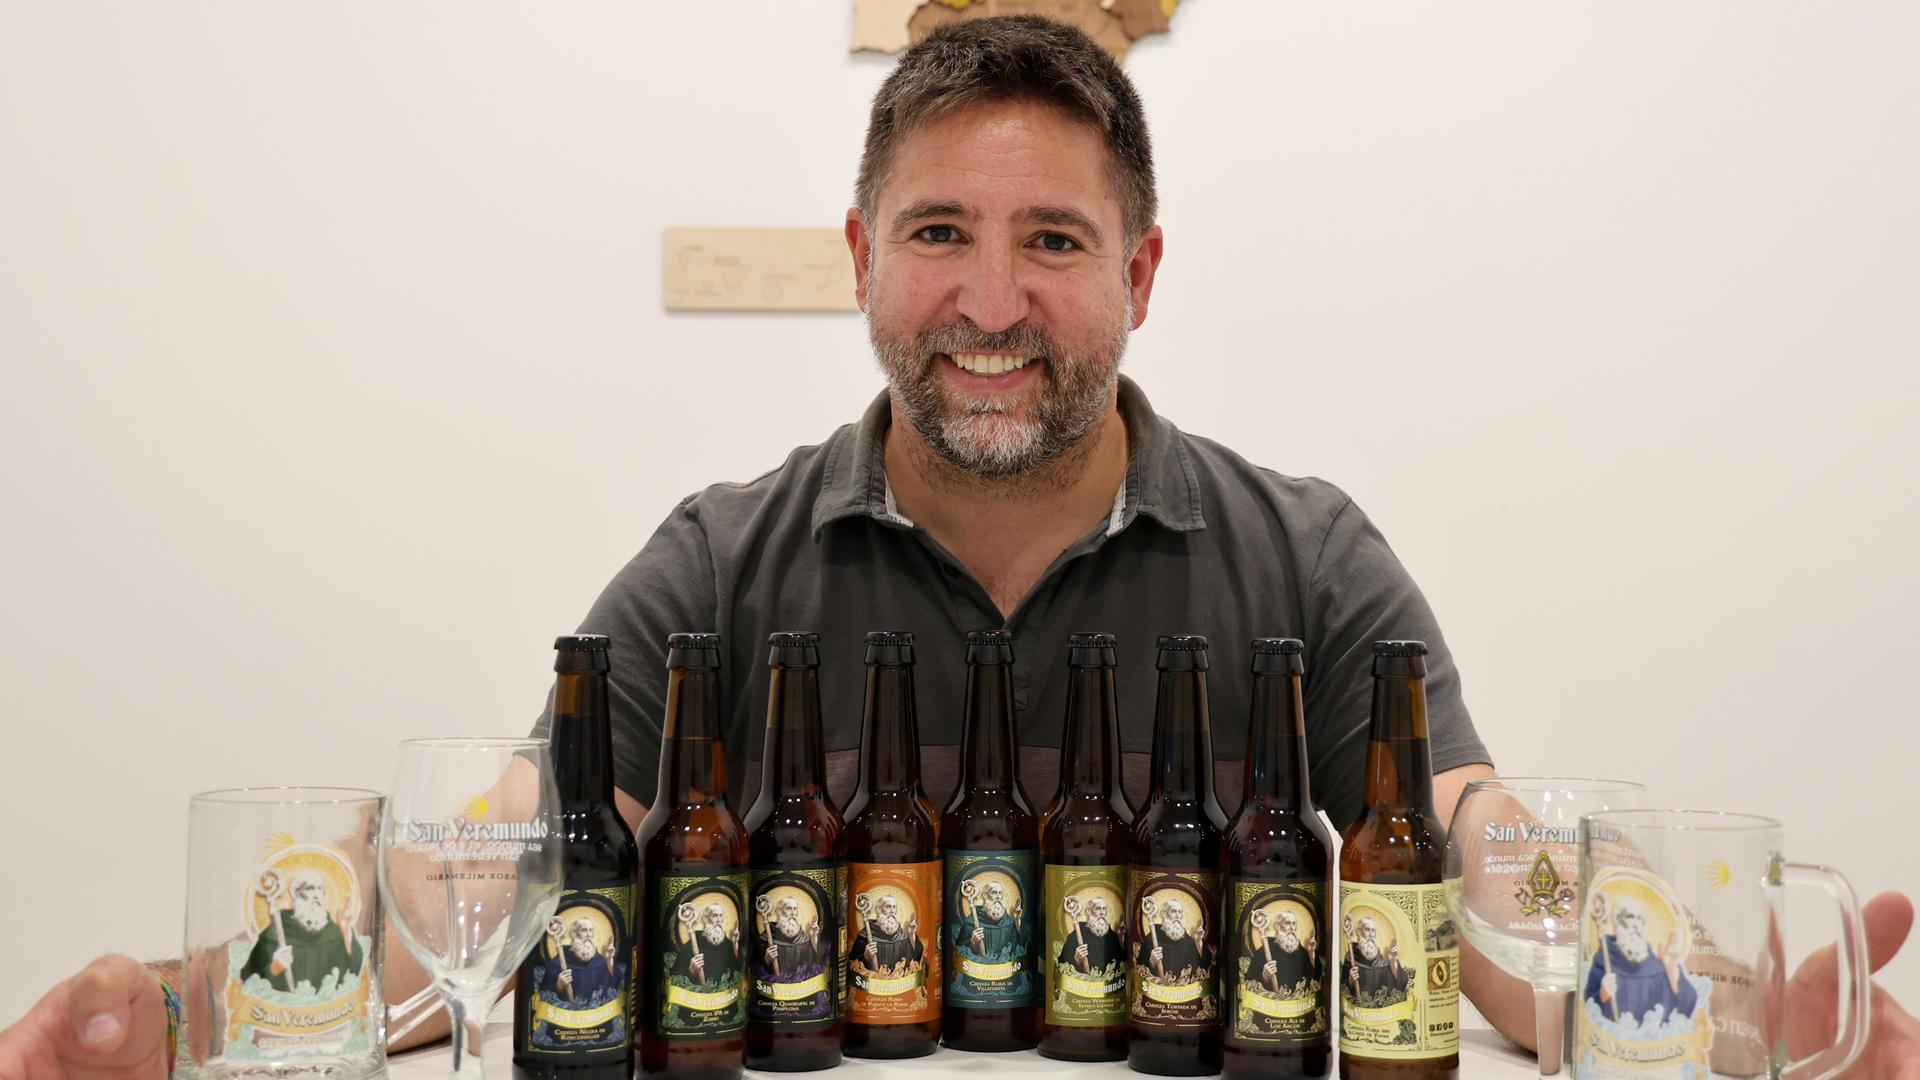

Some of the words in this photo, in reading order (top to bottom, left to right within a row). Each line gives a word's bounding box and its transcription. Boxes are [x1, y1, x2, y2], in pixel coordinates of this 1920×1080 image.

[407, 818, 445, 843] San
[448, 817, 549, 843] Veremundo
[1484, 822, 1516, 843] San
